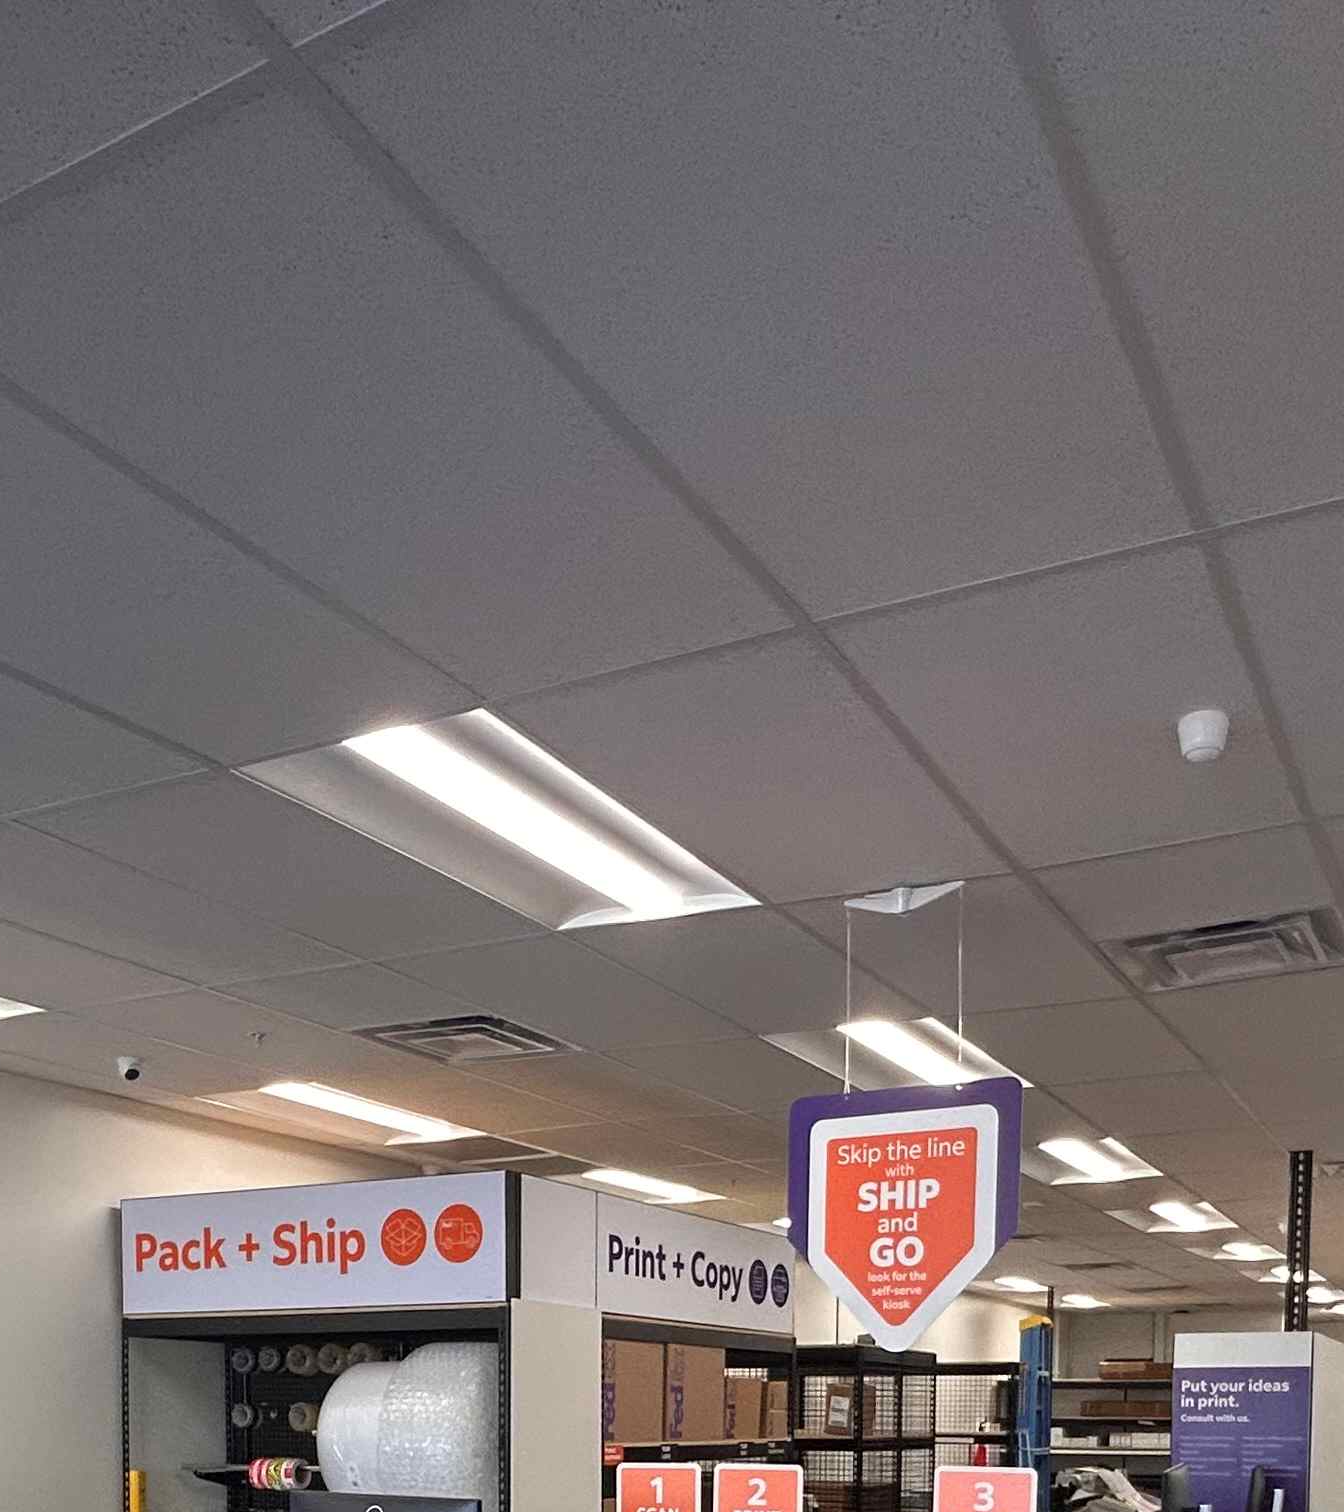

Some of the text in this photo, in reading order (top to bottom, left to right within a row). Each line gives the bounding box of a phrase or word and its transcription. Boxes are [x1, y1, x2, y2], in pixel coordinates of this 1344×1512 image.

[837, 1137, 965, 1167] Skip the line
[885, 1164, 914, 1177] with
[857, 1178, 940, 1212] SHIP
[877, 1212, 918, 1233] and
[135, 1218, 365, 1274] Pack + Ship
[869, 1236, 924, 1267] GO
[609, 1234, 743, 1302] Print + Copy
[867, 1270, 926, 1282] look for the
[872, 1285, 922, 1296] self-serve
[883, 1300, 910, 1310] kiosk
[1181, 1379, 1290, 1395] Put your ideas
[1180, 1395, 1239, 1410] in print.
[1215, 1414, 1235, 1422] with
[649, 1476, 664, 1504] 1
[747, 1478, 768, 1506] 2
[973, 1482, 995, 1512] 3
